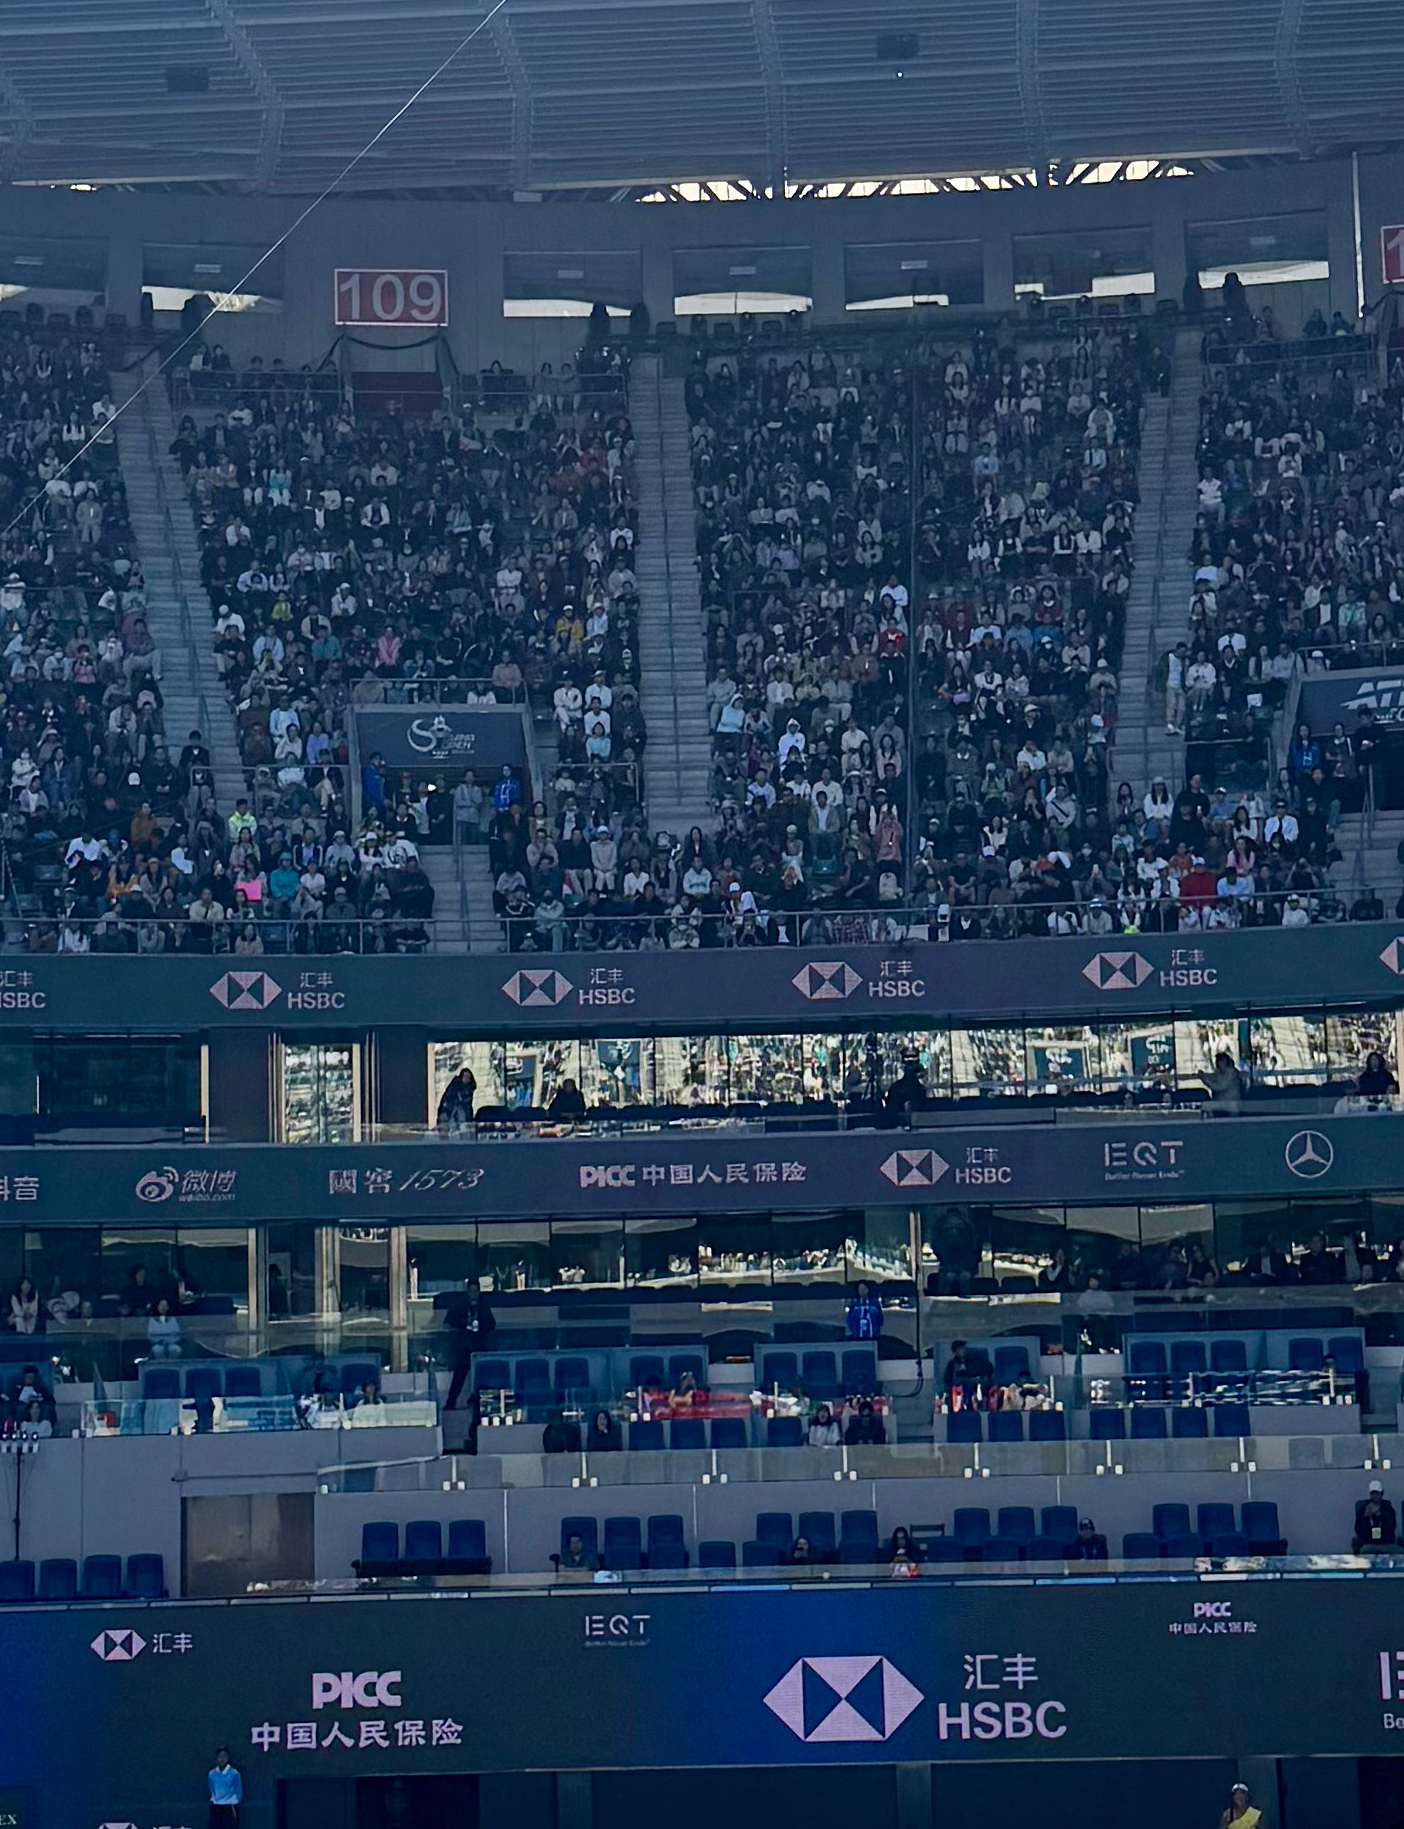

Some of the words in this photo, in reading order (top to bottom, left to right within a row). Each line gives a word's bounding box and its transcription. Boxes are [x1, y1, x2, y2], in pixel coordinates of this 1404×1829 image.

[340, 273, 442, 321] 109
[1171, 949, 1204, 965] 汇丰
[590, 968, 623, 984] 汇丰
[879, 960, 912, 976] 汇丰
[0, 971, 33, 987] 汇丰
[299, 972, 333, 988] 汇丰
[1159, 969, 1217, 987] HSBC
[579, 988, 636, 1005] HSBC
[868, 979, 925, 998] HSBC
[287, 993, 345, 1010] HSBC
[966, 1147, 1000, 1164] 汇丰
[1104, 1141, 1184, 1167] EQT
[181, 1169, 237, 1194] 微博
[399, 1168, 485, 1192] 1573
[579, 1165, 636, 1188] PICC
[642, 1162, 807, 1186] 中国人民保险
[955, 1167, 1012, 1185] HSBC
[1193, 1601, 1232, 1618] PICC
[585, 1614, 651, 1636] EQT
[1169, 1621, 1257, 1635] 中国人民保险
[152, 1632, 193, 1653] 汇丰
[963, 1653, 1039, 1690] 汇丰
[312, 1670, 402, 1710] PICC
[938, 1701, 1067, 1740] HSBC
[251, 1717, 464, 1752] 中国人民保险
